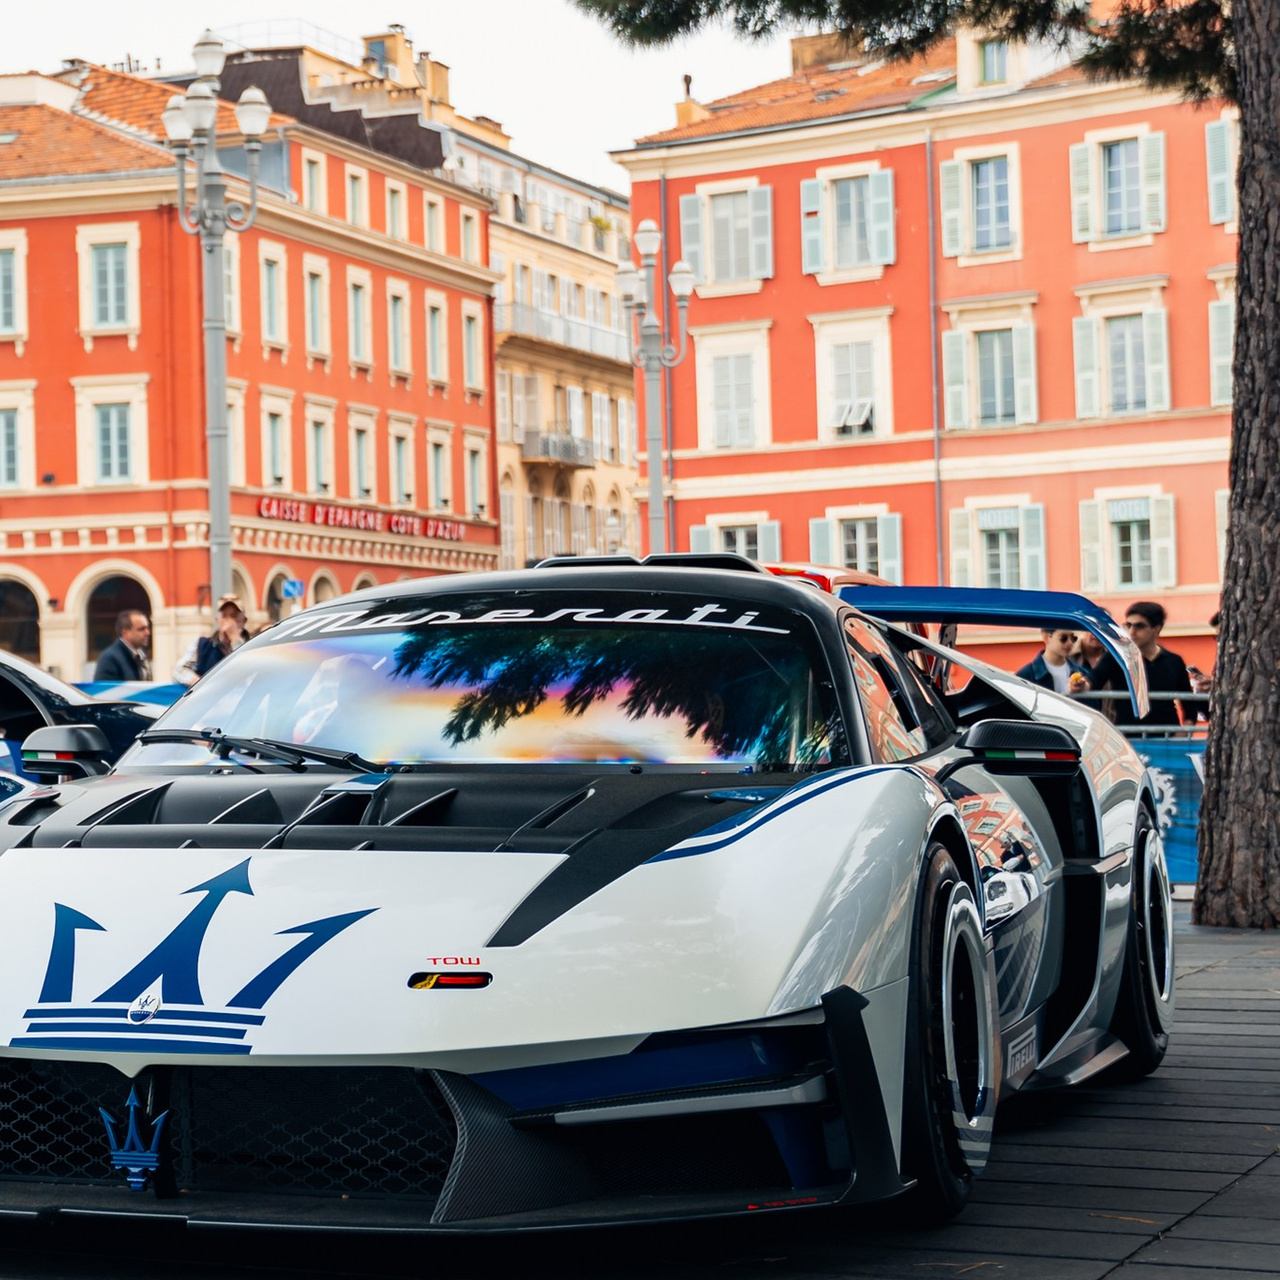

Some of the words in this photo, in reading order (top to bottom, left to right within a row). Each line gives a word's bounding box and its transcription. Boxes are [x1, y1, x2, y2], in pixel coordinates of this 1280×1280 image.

[259, 496, 307, 521] CAISSE
[391, 514, 421, 535] COTE
[273, 602, 791, 641] Maserati
[427, 957, 480, 966] TOW
[1007, 1024, 1037, 1079] PIRELLI
